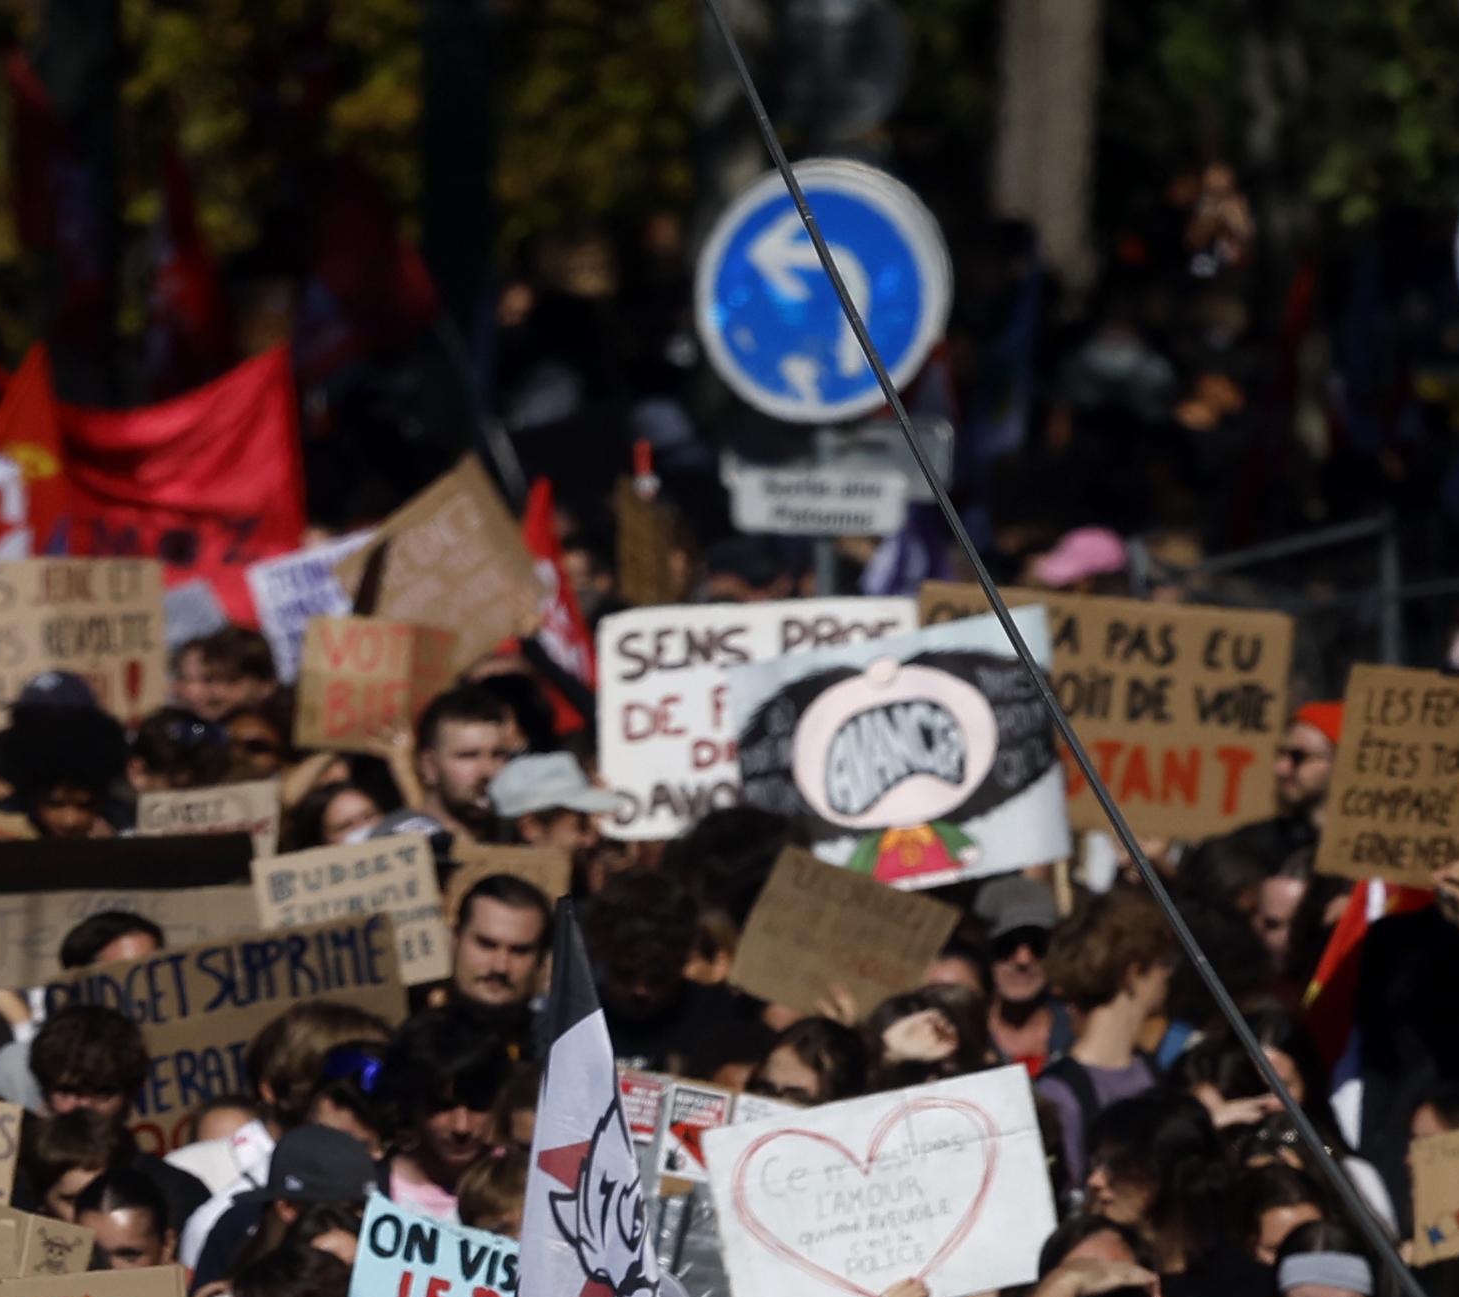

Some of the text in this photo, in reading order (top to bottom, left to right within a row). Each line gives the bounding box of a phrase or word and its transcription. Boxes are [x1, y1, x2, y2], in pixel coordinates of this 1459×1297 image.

[618, 626, 751, 681] SENS
[1105, 620, 1177, 668] PAS
[622, 700, 684, 741] DE
[1365, 687, 1413, 730] LES
[369, 1212, 437, 1268] ON
[845, 1246, 925, 1276] POLICE
